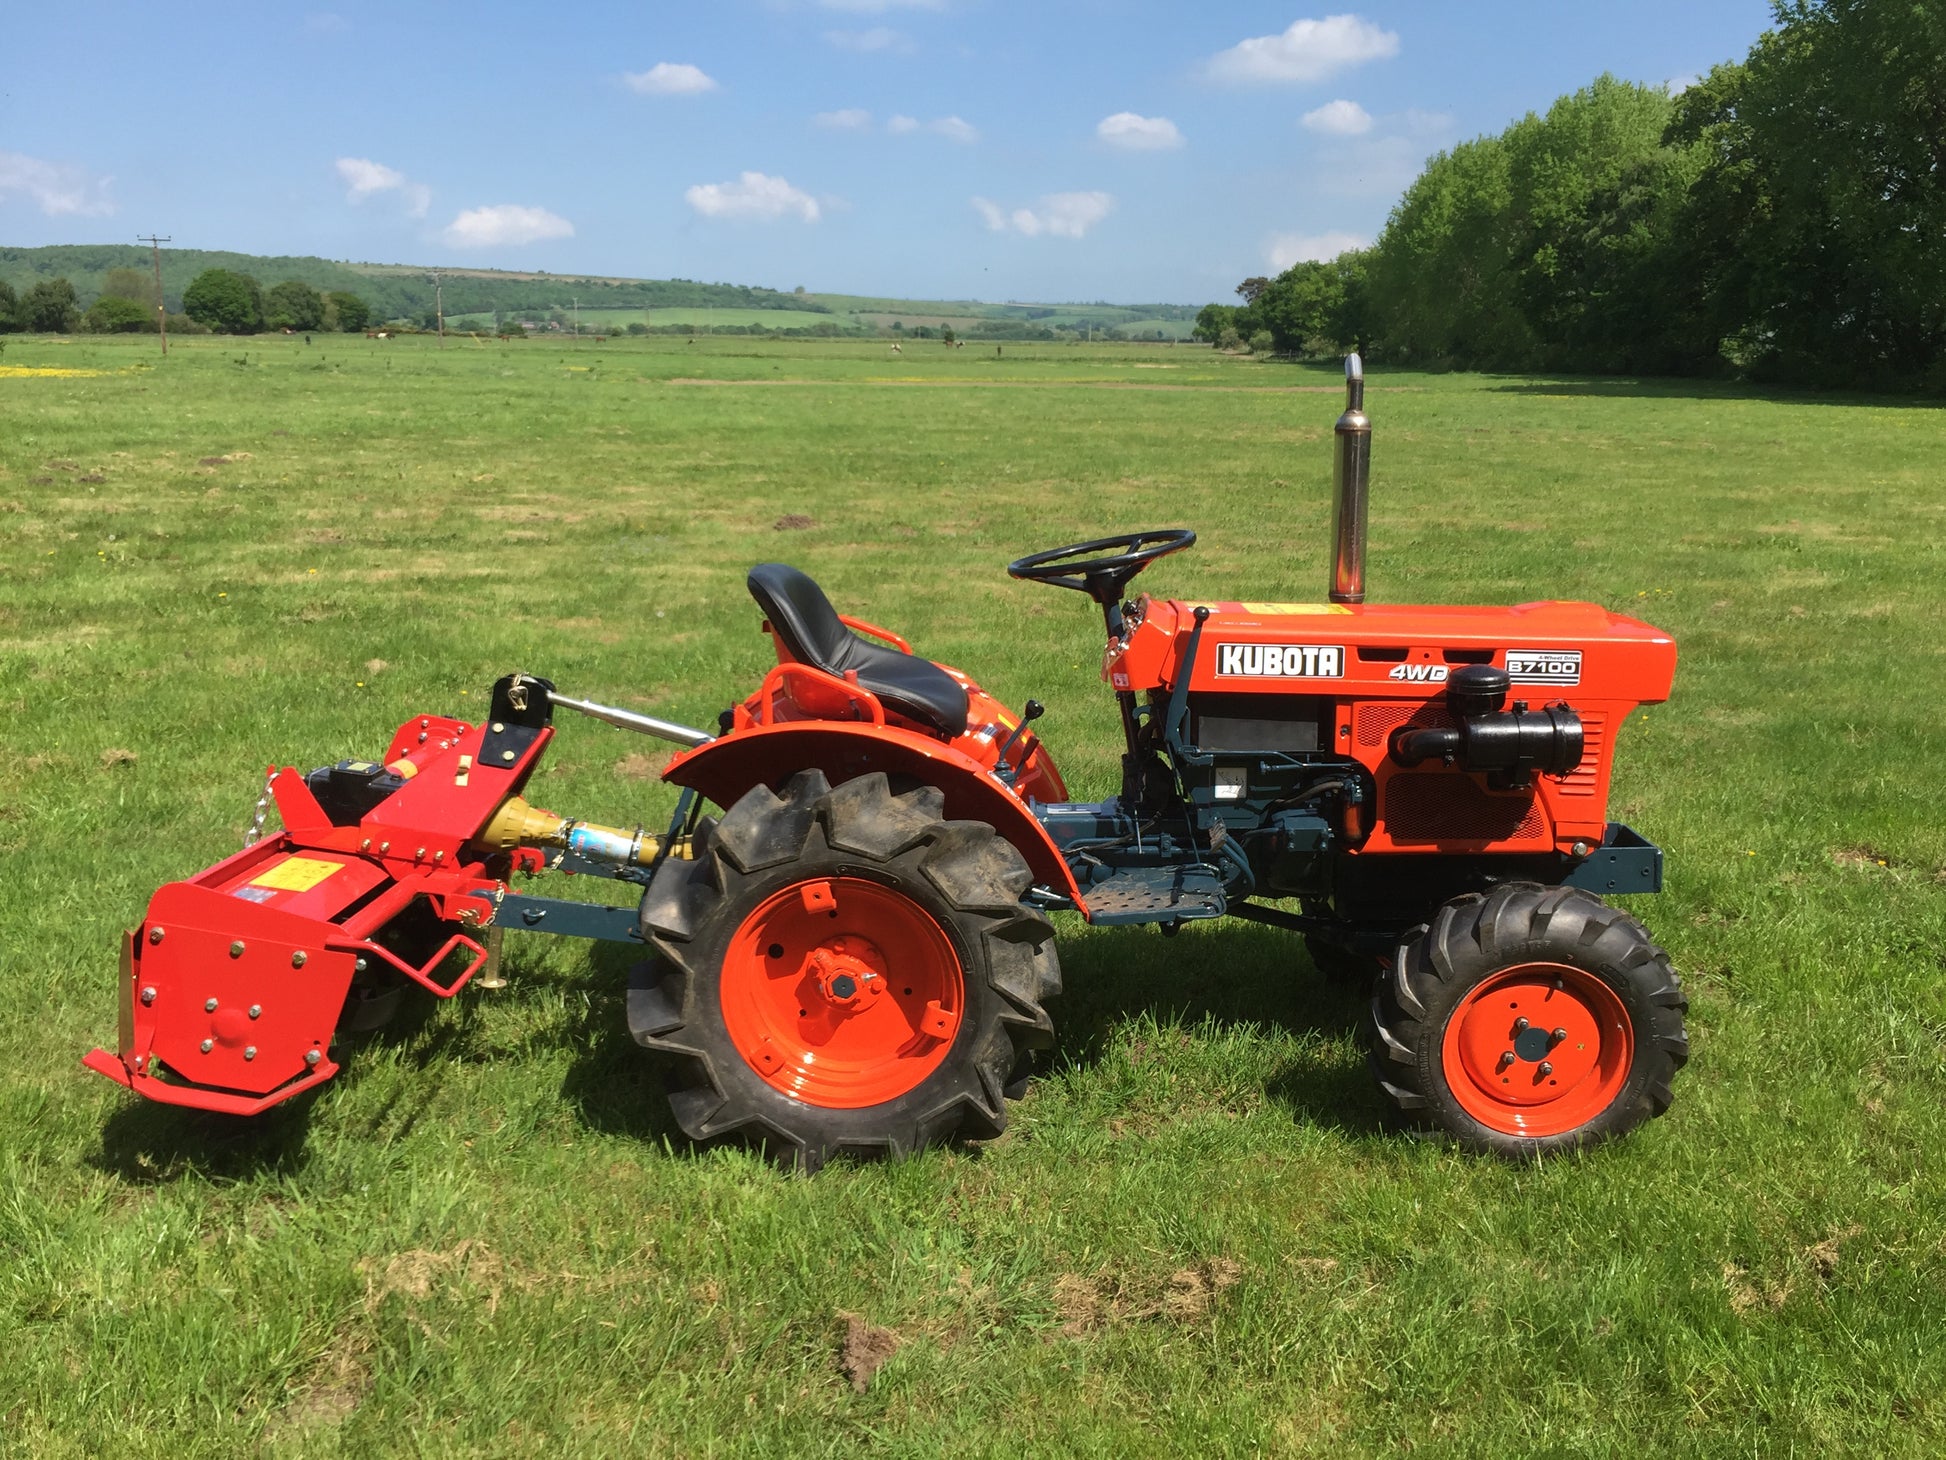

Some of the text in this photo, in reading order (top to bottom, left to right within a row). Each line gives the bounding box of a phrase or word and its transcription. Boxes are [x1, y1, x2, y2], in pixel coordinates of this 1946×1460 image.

[1222, 645, 1339, 676] KUBOTA
[1508, 661, 1576, 673] B7100
[1389, 664, 1449, 682] 4WD
